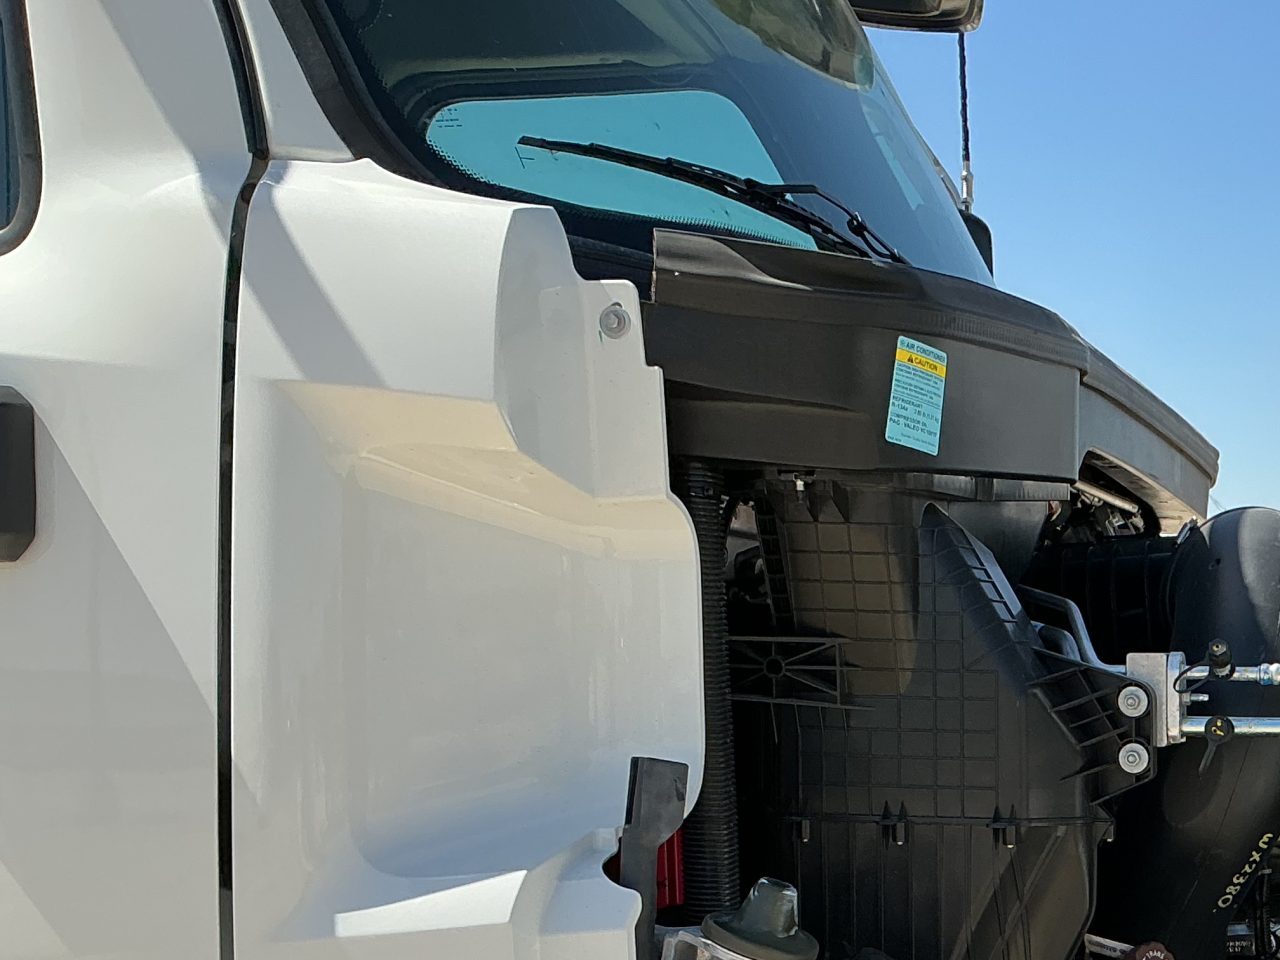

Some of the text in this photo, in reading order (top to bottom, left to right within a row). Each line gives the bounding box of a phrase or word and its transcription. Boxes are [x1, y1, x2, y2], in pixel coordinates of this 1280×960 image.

[906, 341, 946, 363] AIR CONDITIONER
[914, 357, 938, 372] CAUTION
